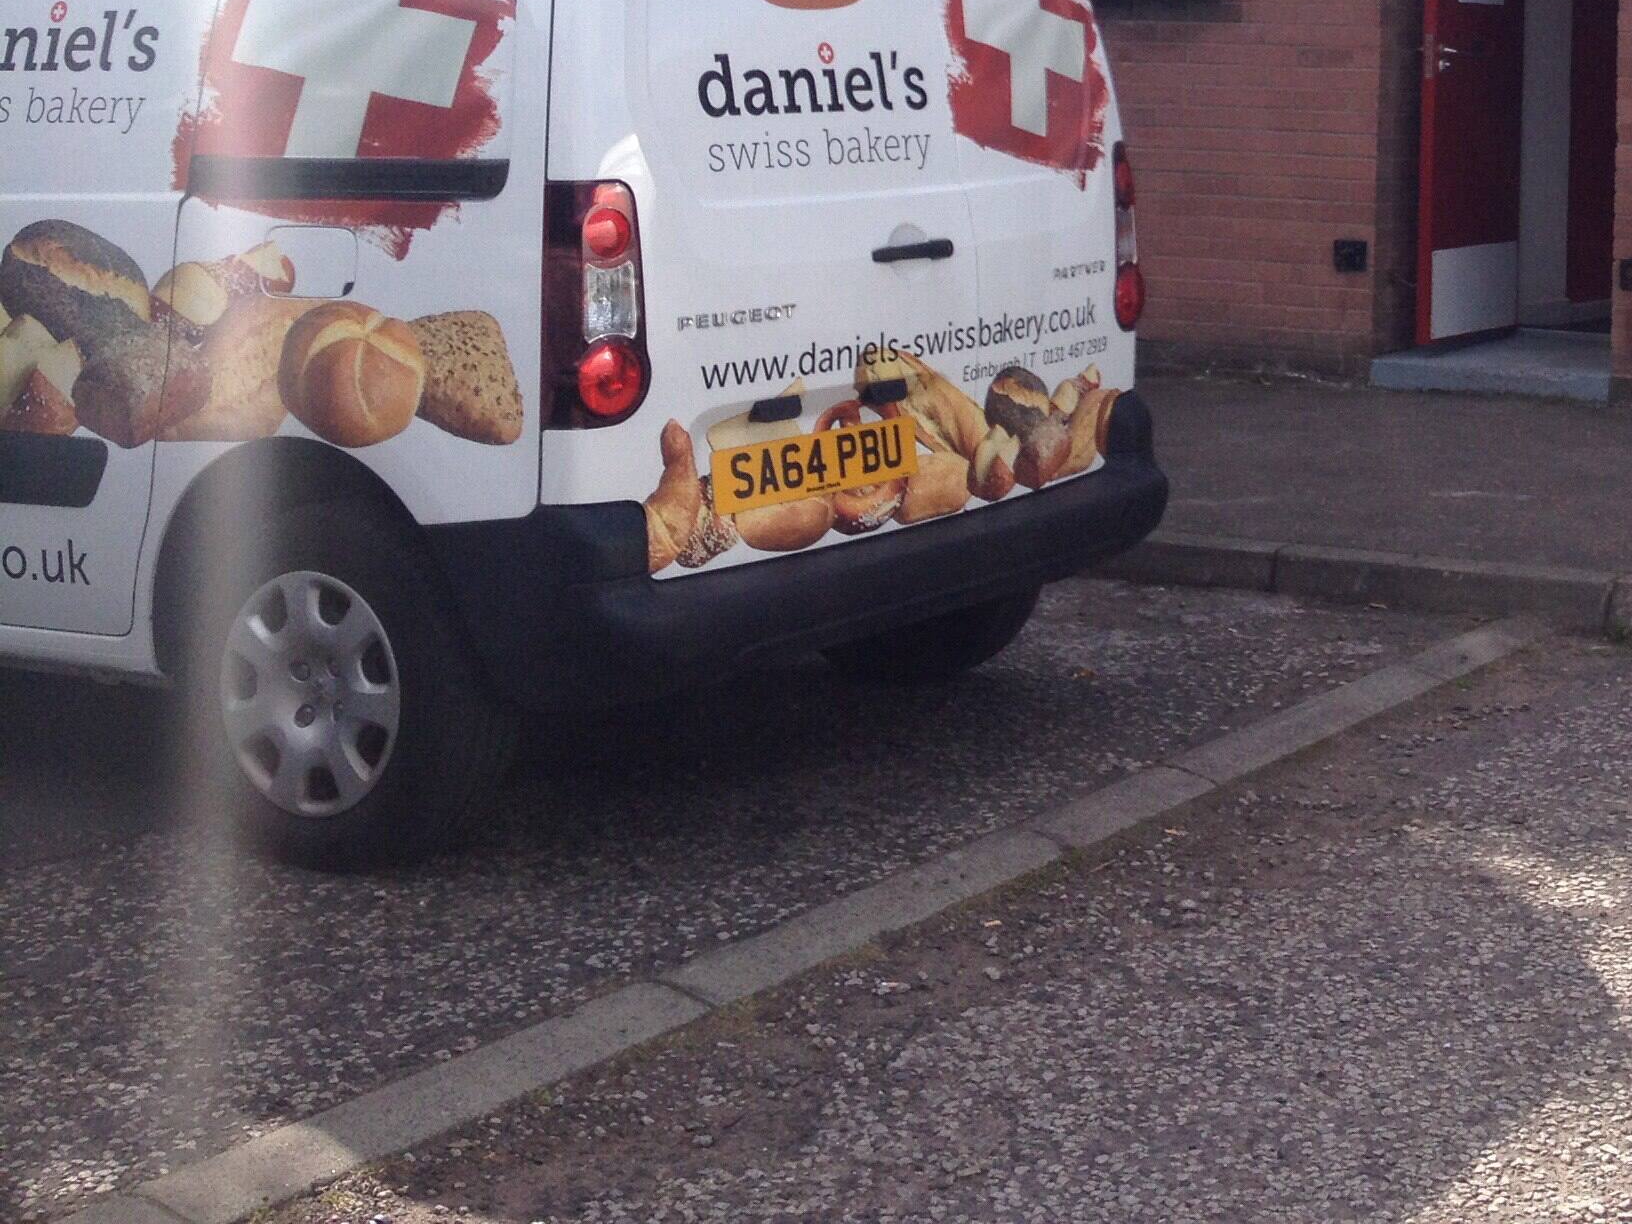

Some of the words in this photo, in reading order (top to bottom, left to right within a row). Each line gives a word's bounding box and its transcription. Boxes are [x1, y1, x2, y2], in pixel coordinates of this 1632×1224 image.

[26, 87, 146, 134] bakery
[698, 41, 929, 118] daniel's
[707, 131, 811, 173] swiss
[823, 126, 931, 170] bakery
[677, 303, 797, 331] PEUGEOT
[700, 296, 1095, 390] www.daniels-swissbakery.co.uk
[730, 430, 827, 501] SA64
[837, 424, 903, 479] PBU
